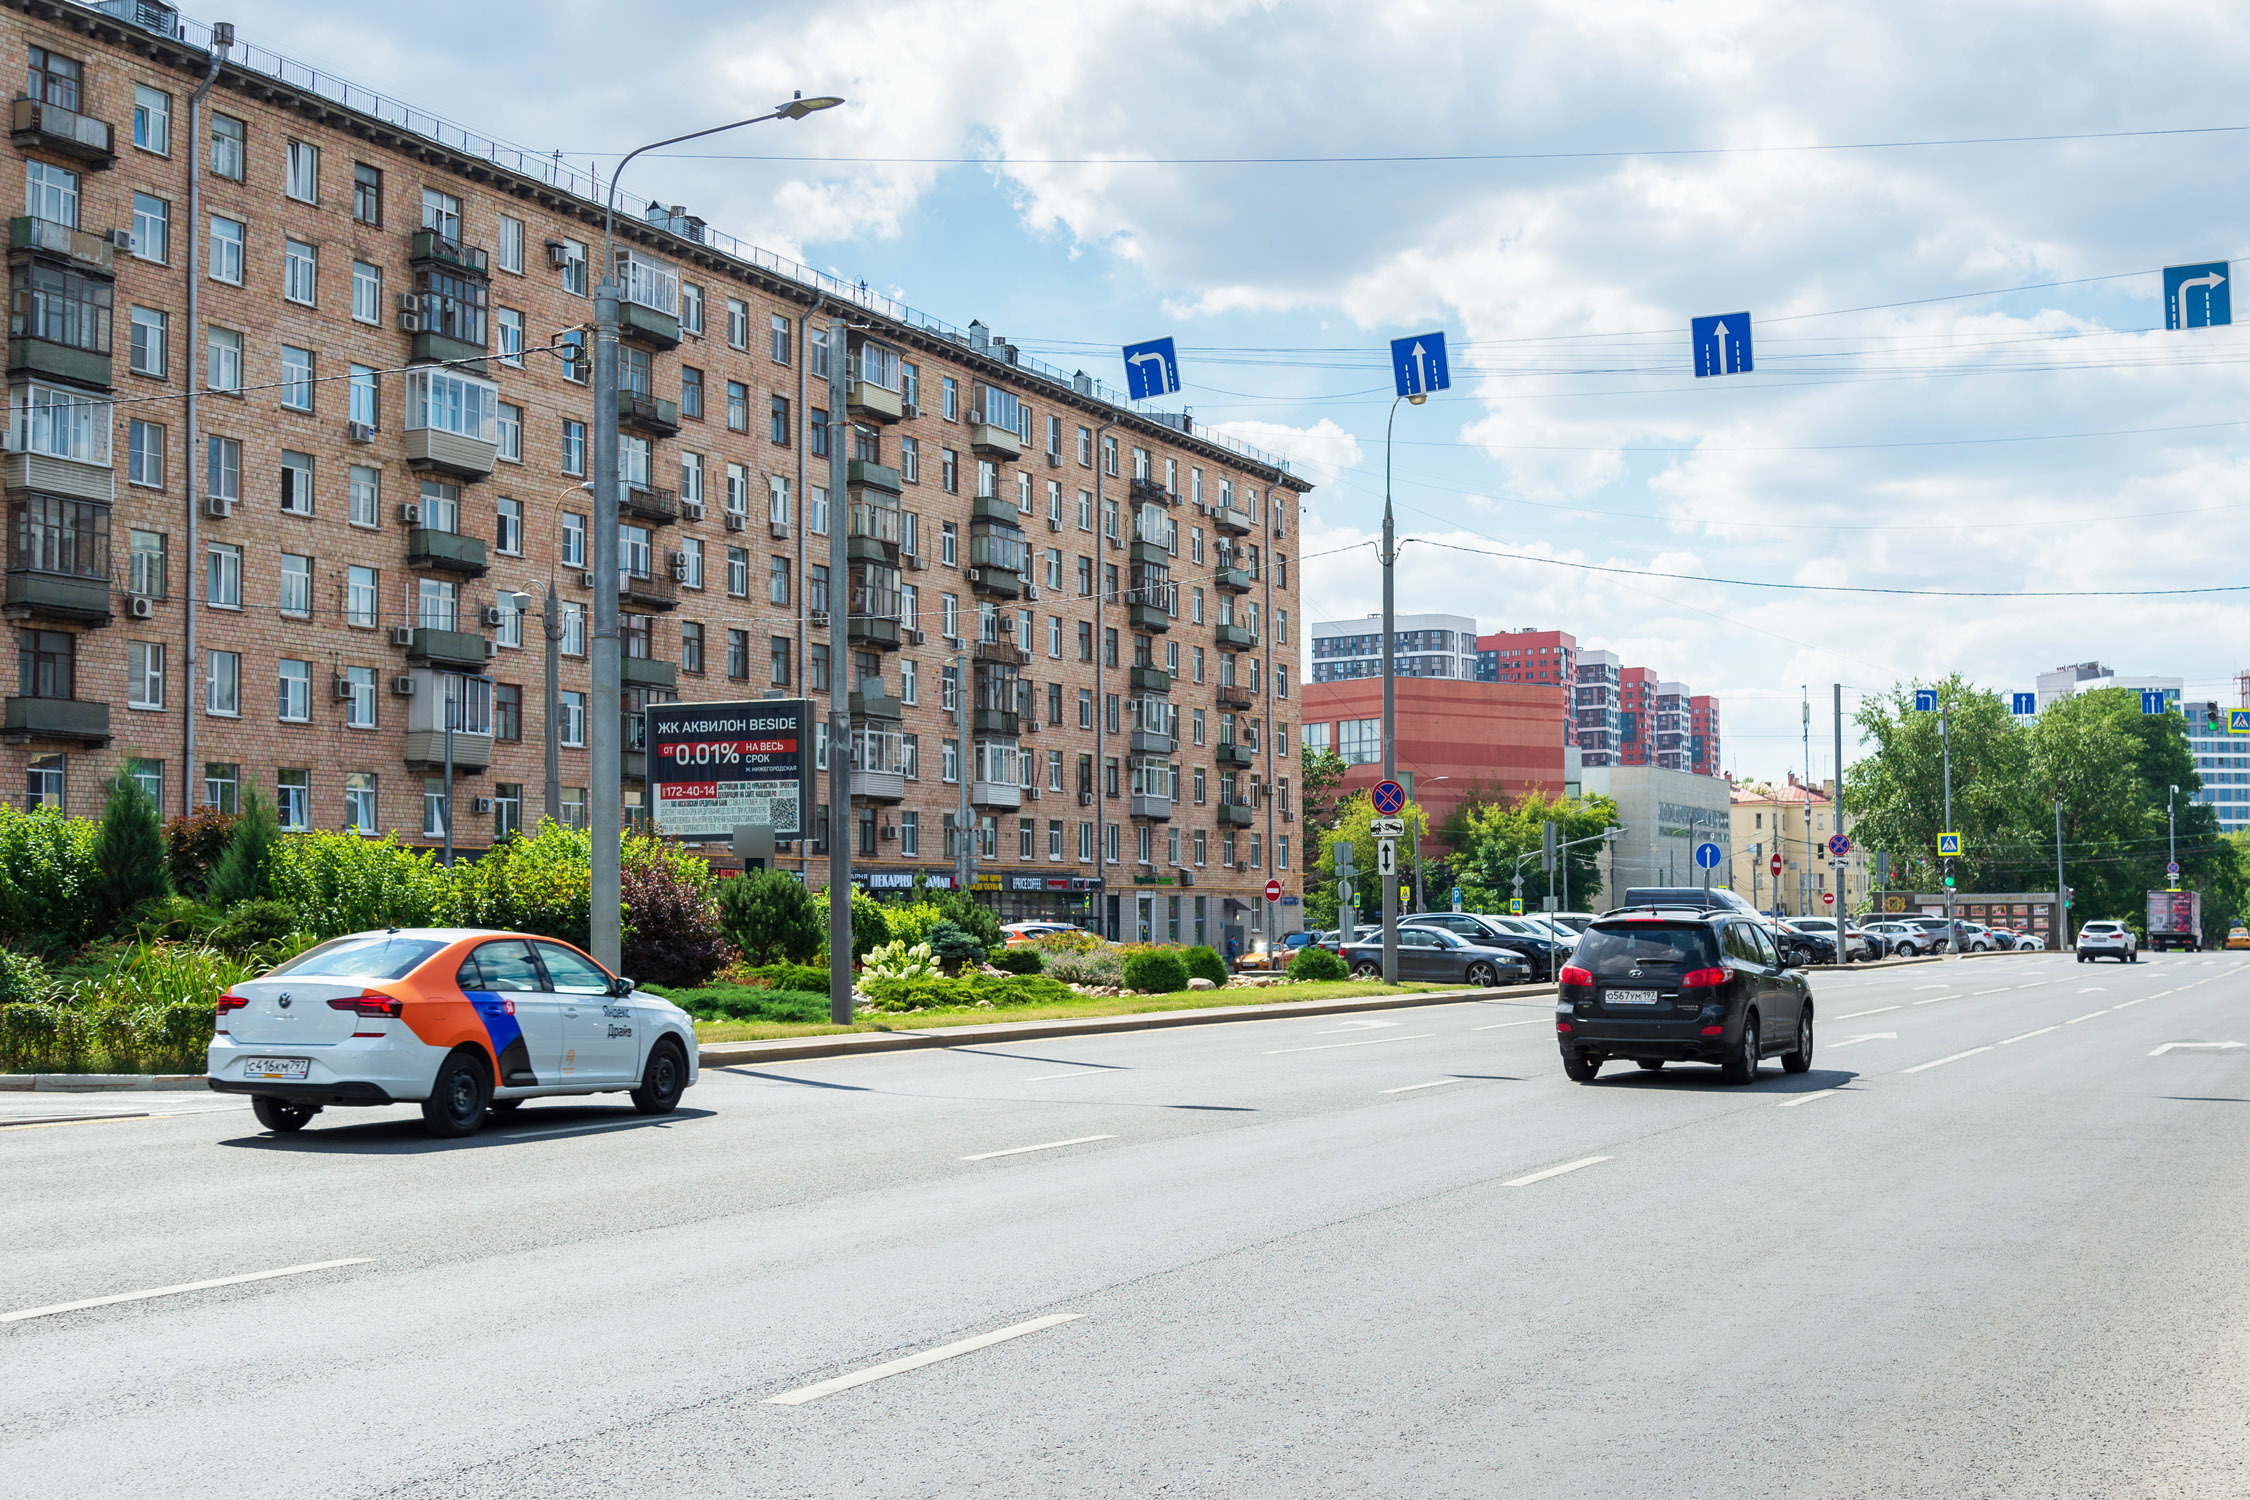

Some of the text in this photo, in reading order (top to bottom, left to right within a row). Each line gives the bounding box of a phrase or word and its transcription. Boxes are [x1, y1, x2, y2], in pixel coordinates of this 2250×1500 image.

[658, 717, 797, 734] ЖК АКВИЛОН BESIDE
[745, 741, 784, 752] НА ВЕСЬ
[663, 742, 740, 765] ОТ 0.01%
[745, 753, 770, 764] СРОК
[666, 785, 716, 797] 172-40-14
[869, 874, 913, 888] ПЕКАРНЯ
[1606, 990, 1656, 1001] О567УМ 197
[506, 1000, 514, 1013] Я
[602, 1004, 631, 1020] Яндекс
[607, 1023, 632, 1039] Драйв
[289, 1059, 307, 1071] 797
